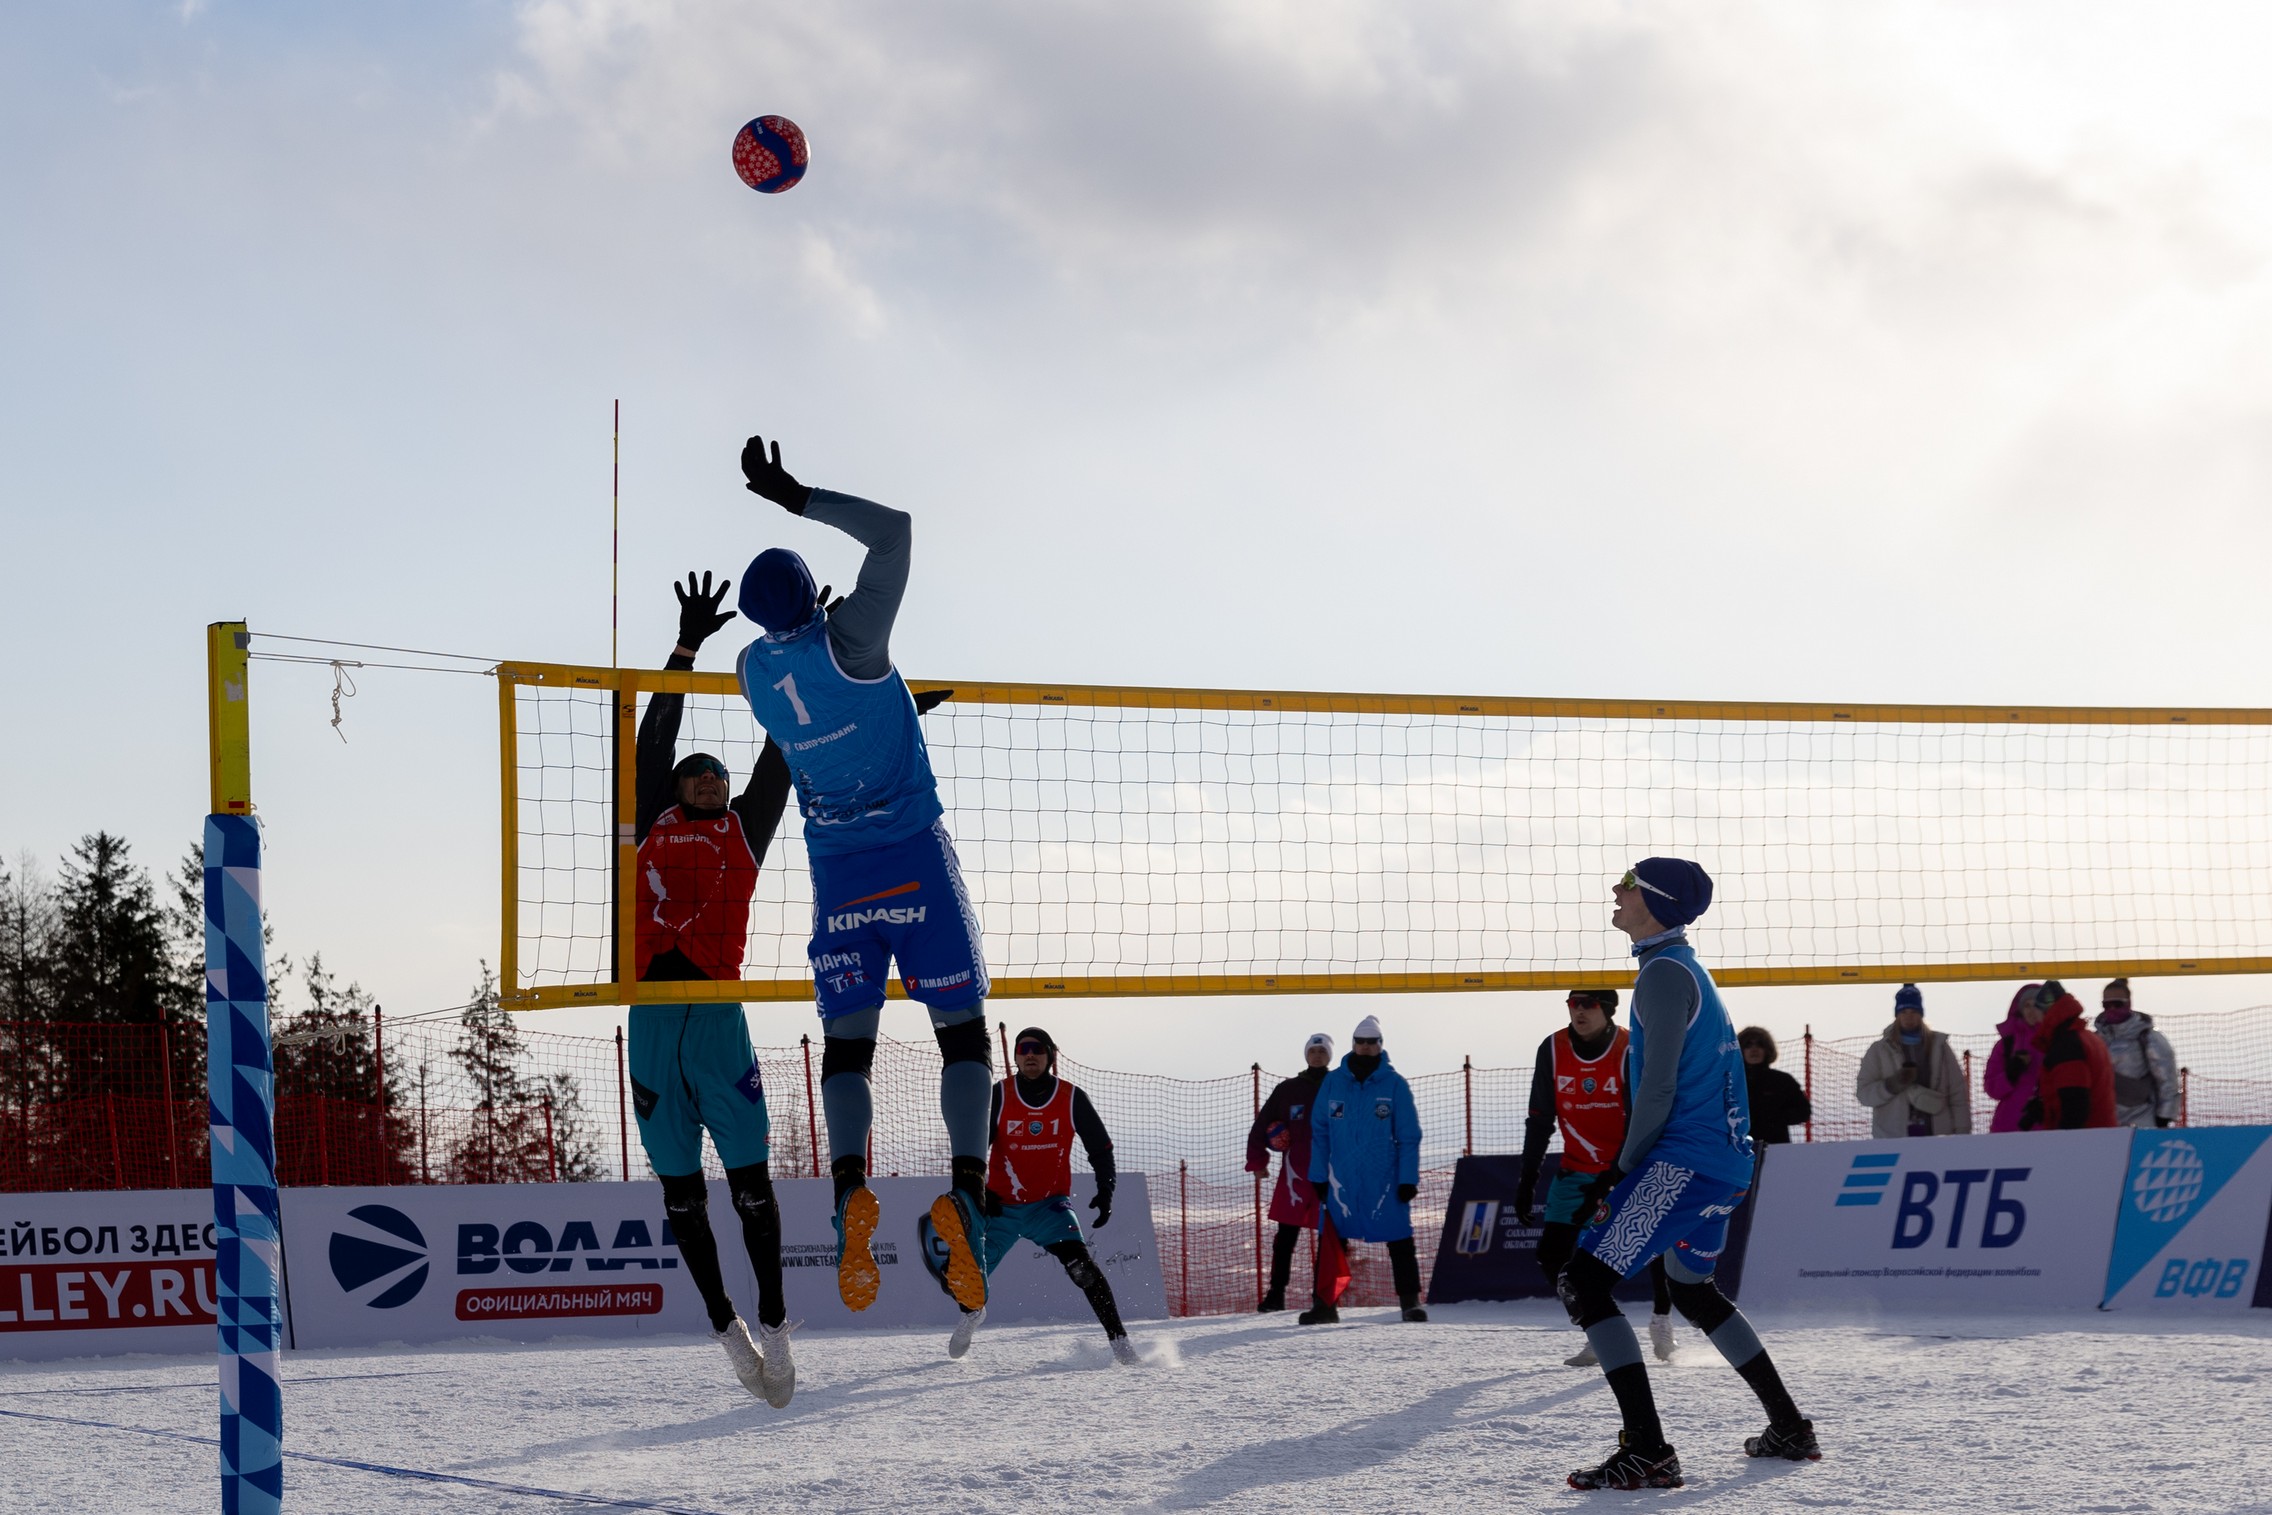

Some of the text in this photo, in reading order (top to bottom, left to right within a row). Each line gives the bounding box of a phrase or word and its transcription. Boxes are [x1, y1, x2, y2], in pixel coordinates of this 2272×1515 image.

[772, 672, 812, 726] 1
[827, 906, 927, 934] KINASH
[919, 969, 970, 988] YAMAGUCHI
[1602, 1076, 1619, 1095] 4
[1050, 1118, 1060, 1135] 1
[1892, 1168, 2032, 1249] ВТБ
[130, 1223, 217, 1256] ЗДЕС
[2154, 1258, 2249, 1298] ВФВ
[466, 1290, 653, 1313] ОФИЦИАЛЬНЫЙ МЯЧ
